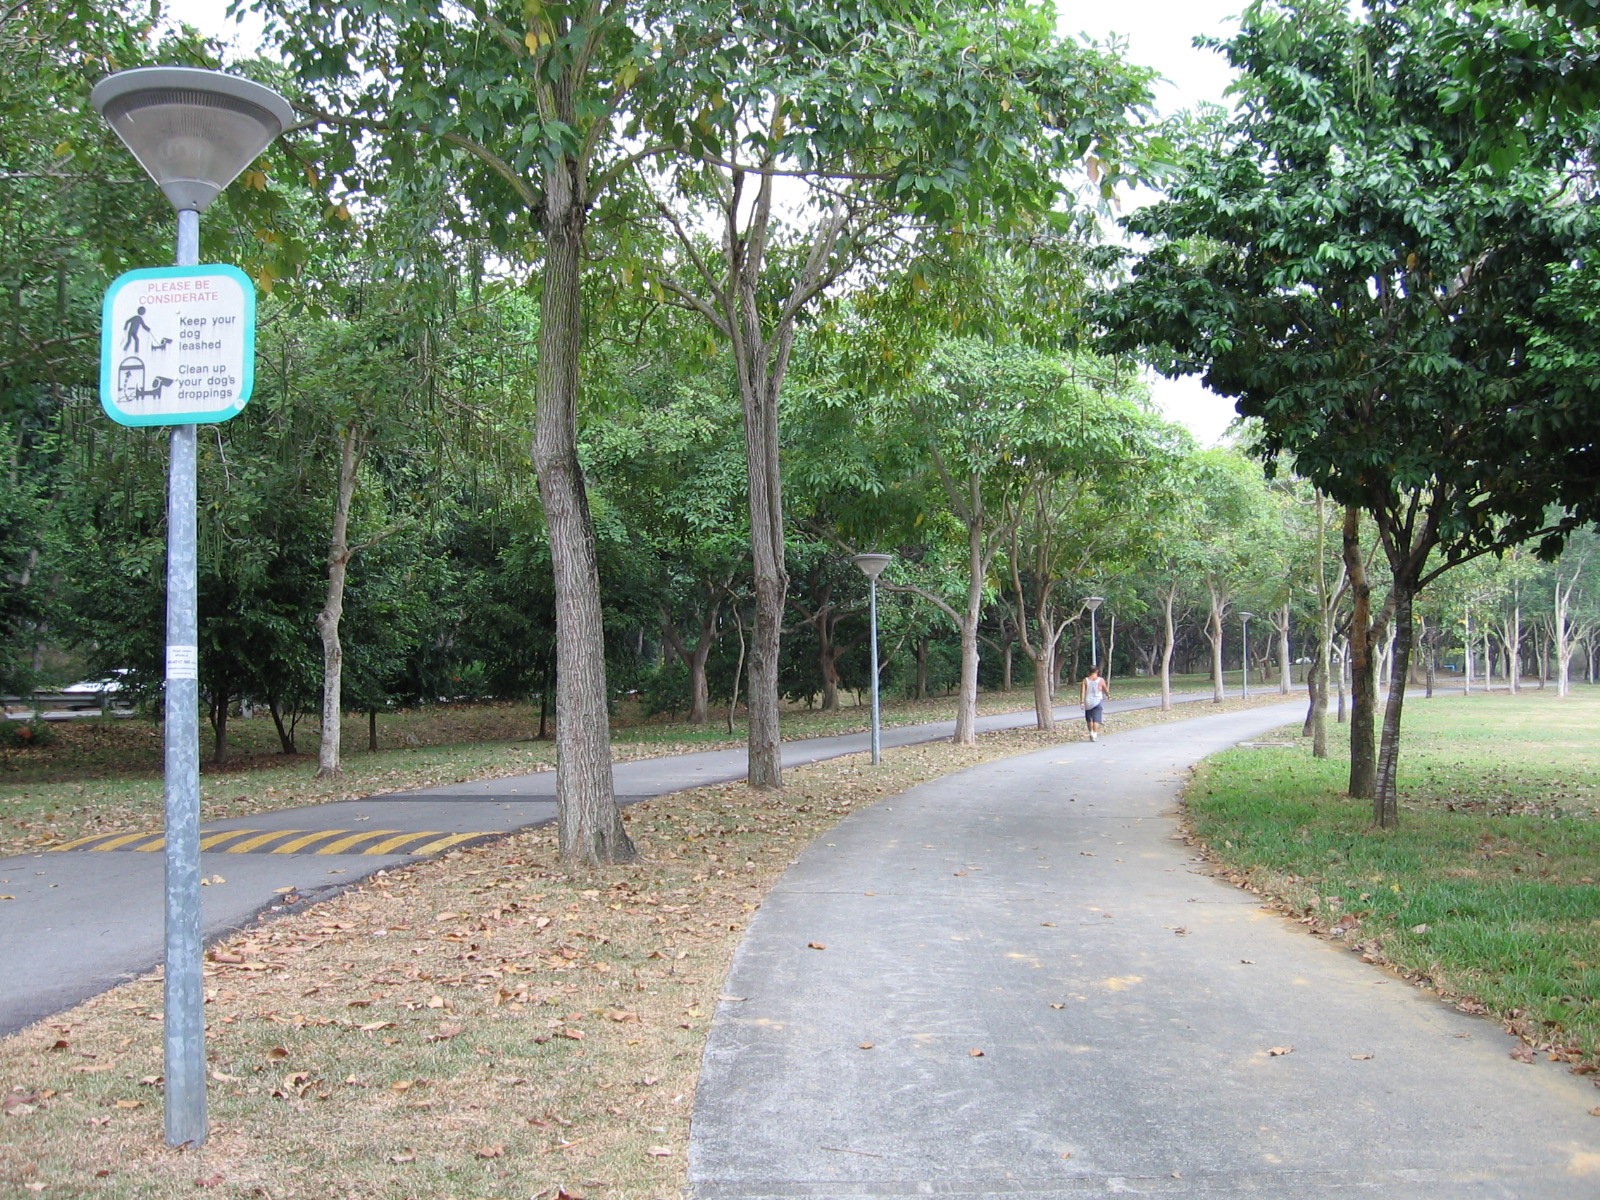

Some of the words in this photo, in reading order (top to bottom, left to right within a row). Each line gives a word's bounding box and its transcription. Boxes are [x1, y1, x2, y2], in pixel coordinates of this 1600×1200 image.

[148, 281, 191, 292] PLEASE
[195, 280, 210, 290] BE
[139, 291, 219, 305] CONSIDERATE
[179, 316, 207, 328] Keep
[212, 316, 236, 327] your
[179, 329, 201, 339] dog
[179, 339, 222, 351] leashed
[178, 364, 209, 374] Clean
[212, 364, 226, 374] up
[178, 377, 203, 388] your
[207, 375, 236, 387] dog's
[178, 387, 233, 400] droppings
